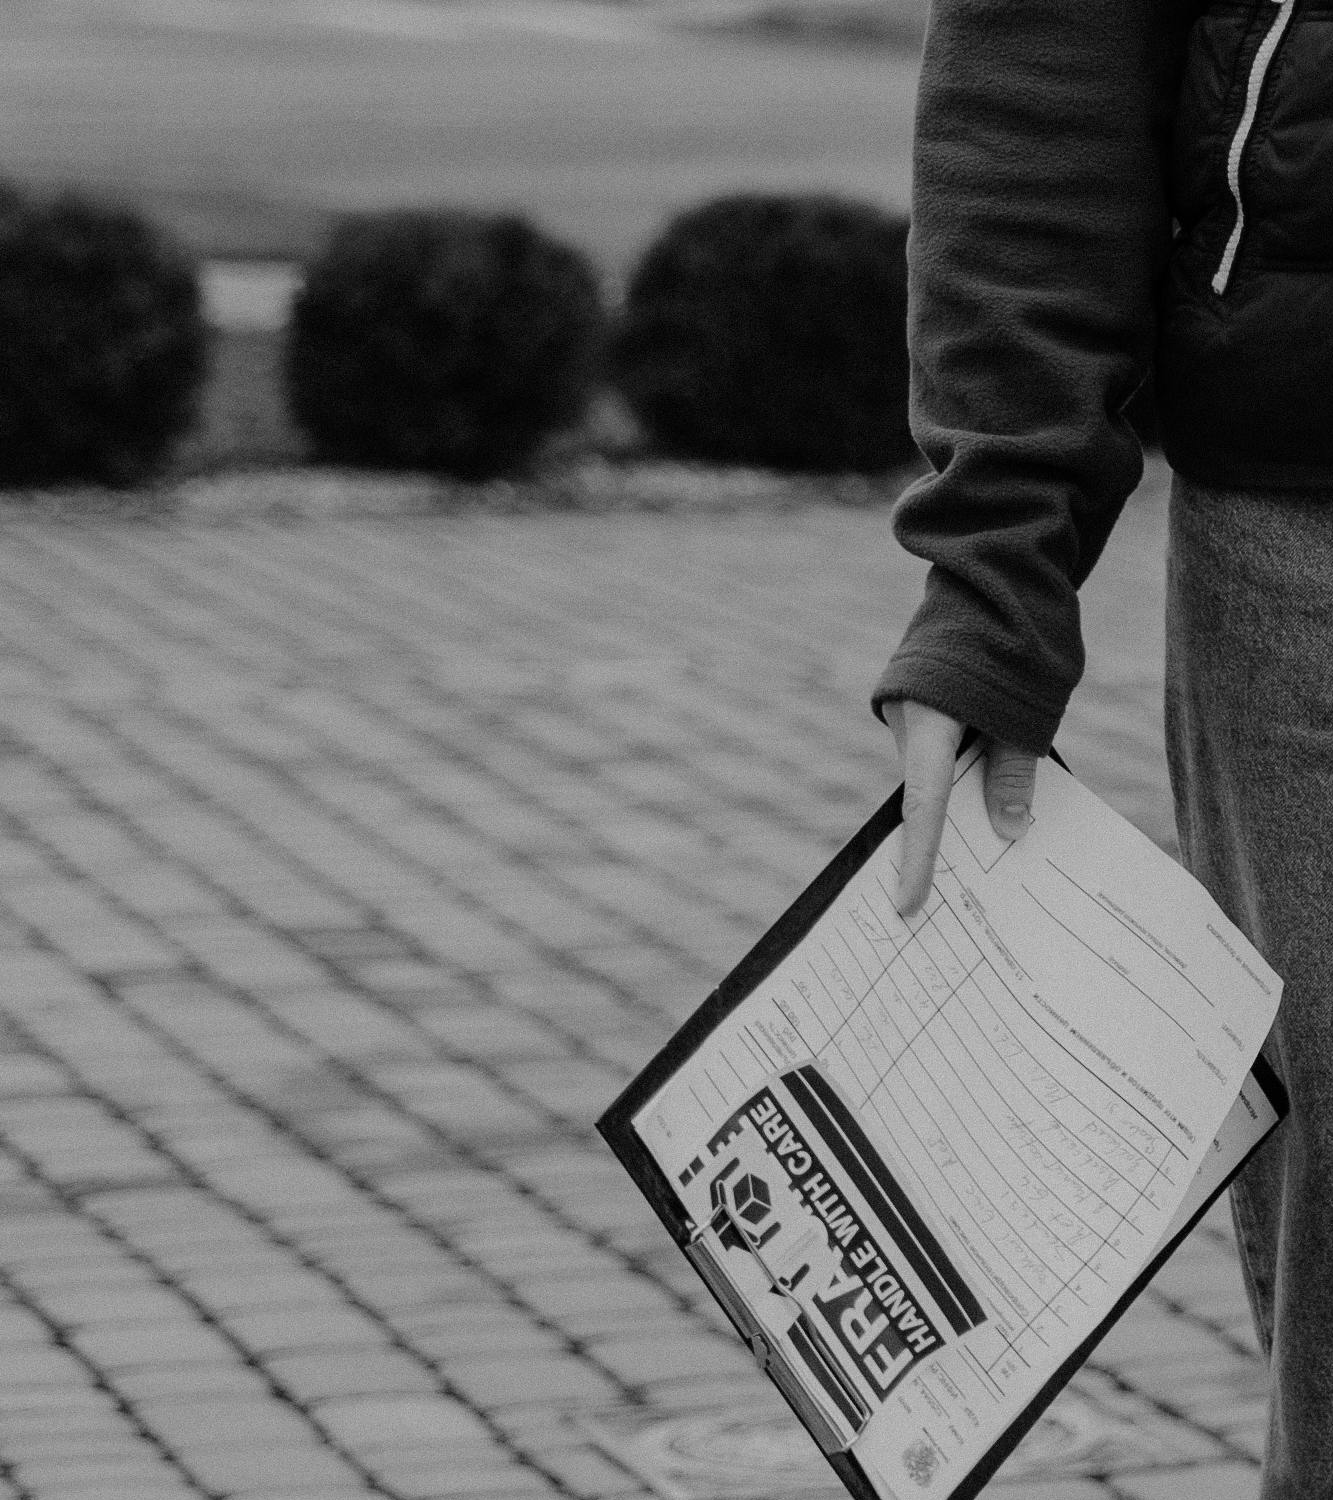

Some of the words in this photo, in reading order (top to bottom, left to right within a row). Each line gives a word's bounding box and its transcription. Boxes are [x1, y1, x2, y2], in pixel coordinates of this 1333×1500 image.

[749, 1096, 812, 1176] CARE
[802, 1173, 860, 1248] WITH
[849, 1240, 936, 1353] HANDLE
